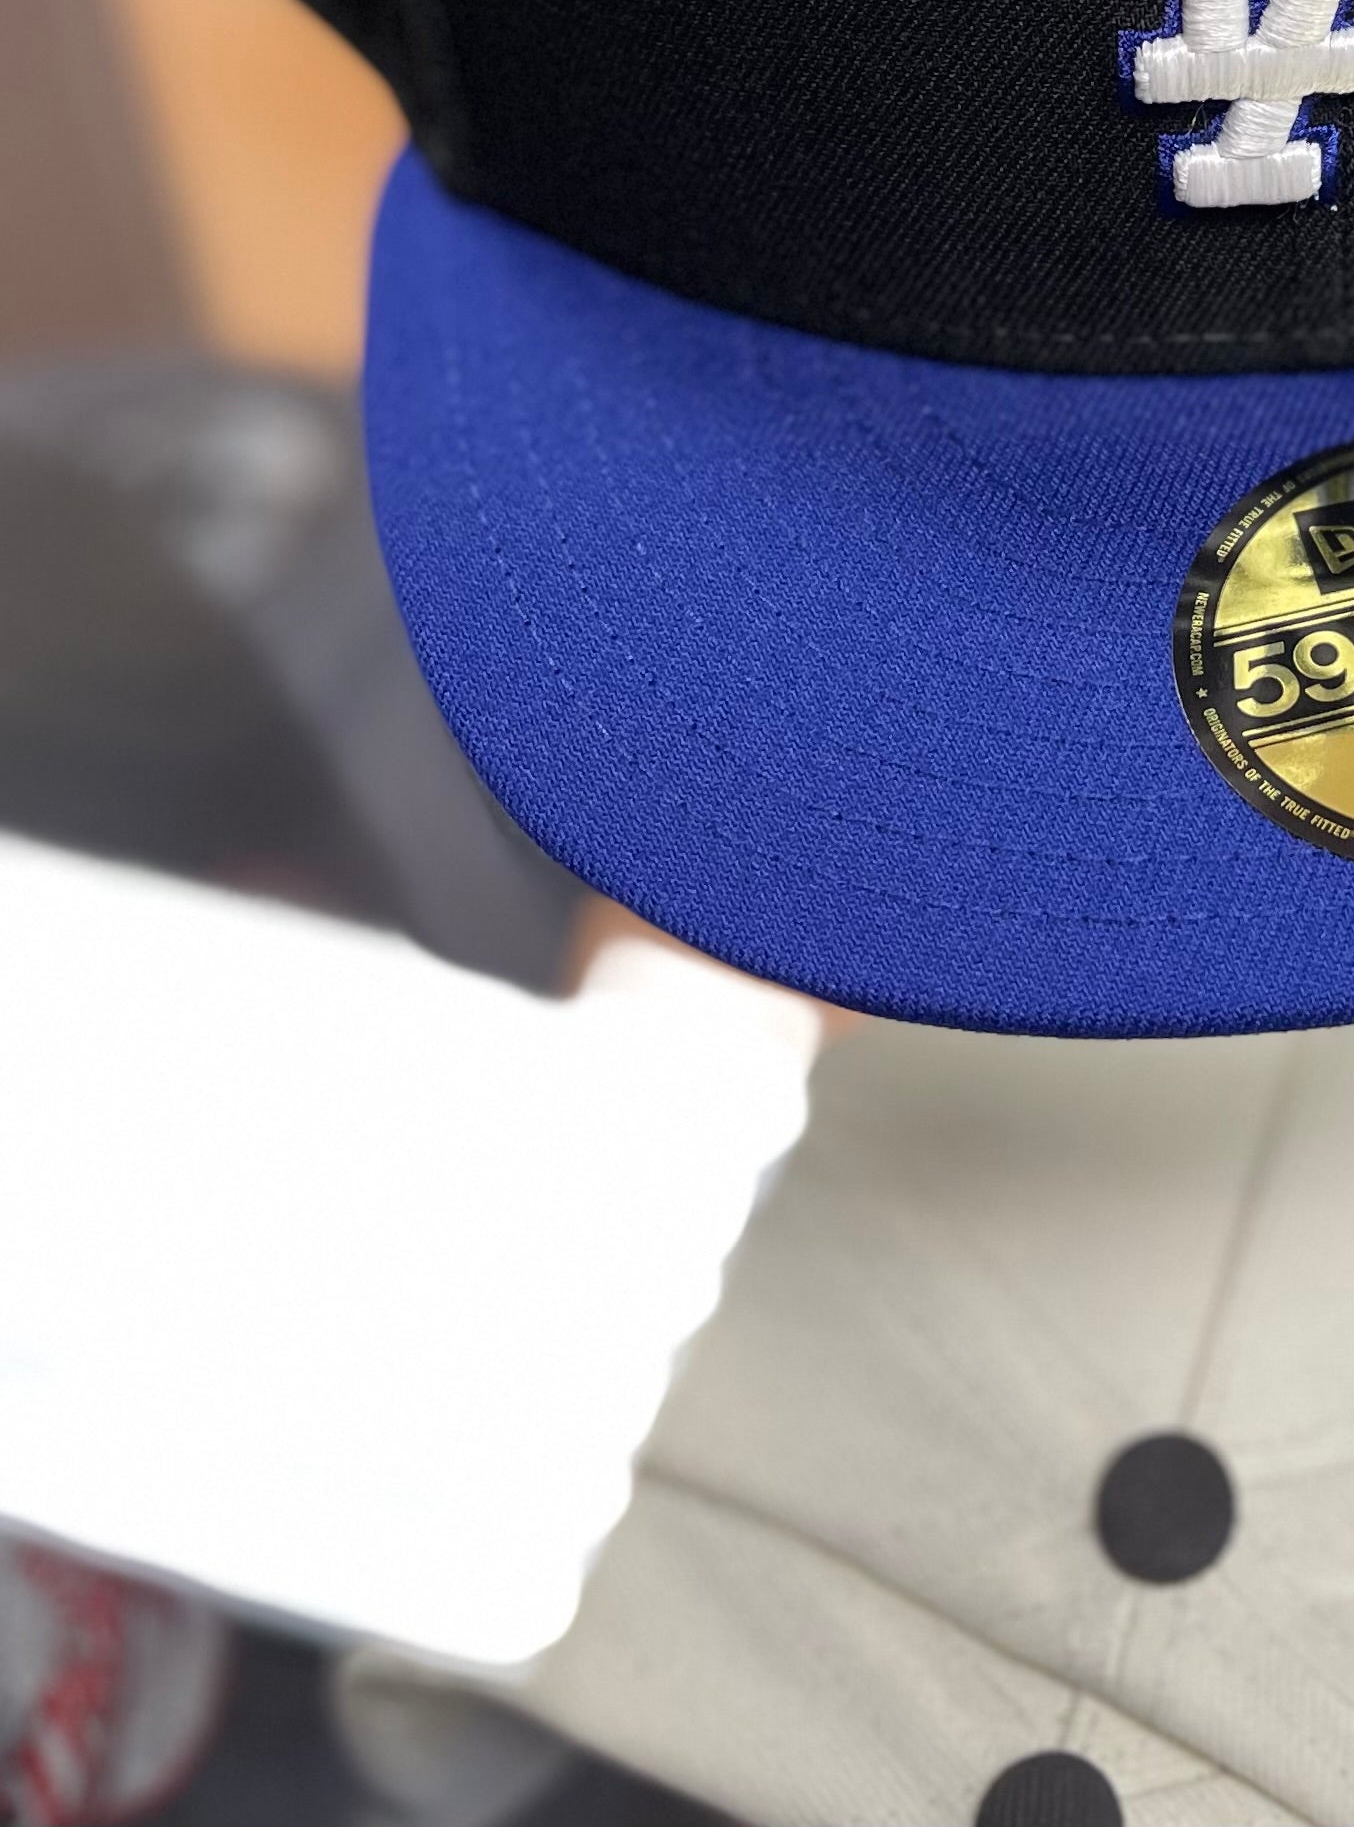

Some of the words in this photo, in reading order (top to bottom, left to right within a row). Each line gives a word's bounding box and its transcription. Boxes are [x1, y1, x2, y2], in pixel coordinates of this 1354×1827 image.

[1237, 505, 1264, 531] TRUE
[1189, 591, 1210, 676] NEWERACAP.COM
[1203, 707, 1249, 770] ORIGINATORS
[1245, 768, 1262, 782] OF
[1258, 779, 1281, 801] THE
[1280, 795, 1311, 820] TRUE
